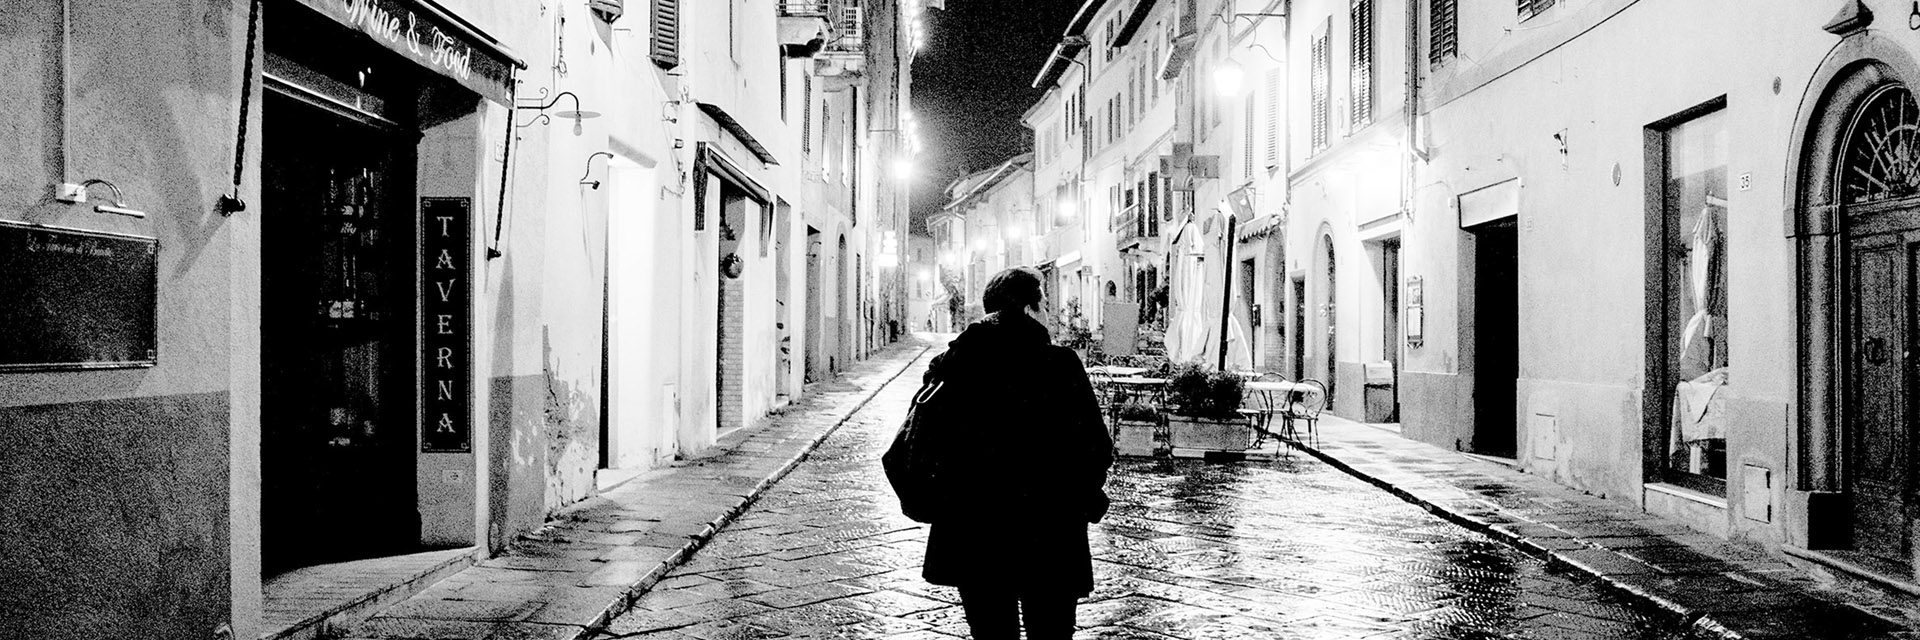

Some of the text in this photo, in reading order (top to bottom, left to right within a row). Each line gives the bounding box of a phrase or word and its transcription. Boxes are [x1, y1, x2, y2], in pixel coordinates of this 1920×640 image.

[344, 0, 472, 80] Wine & Food
[1741, 175, 1750, 189] 35
[436, 216, 456, 433] TAVERNA
